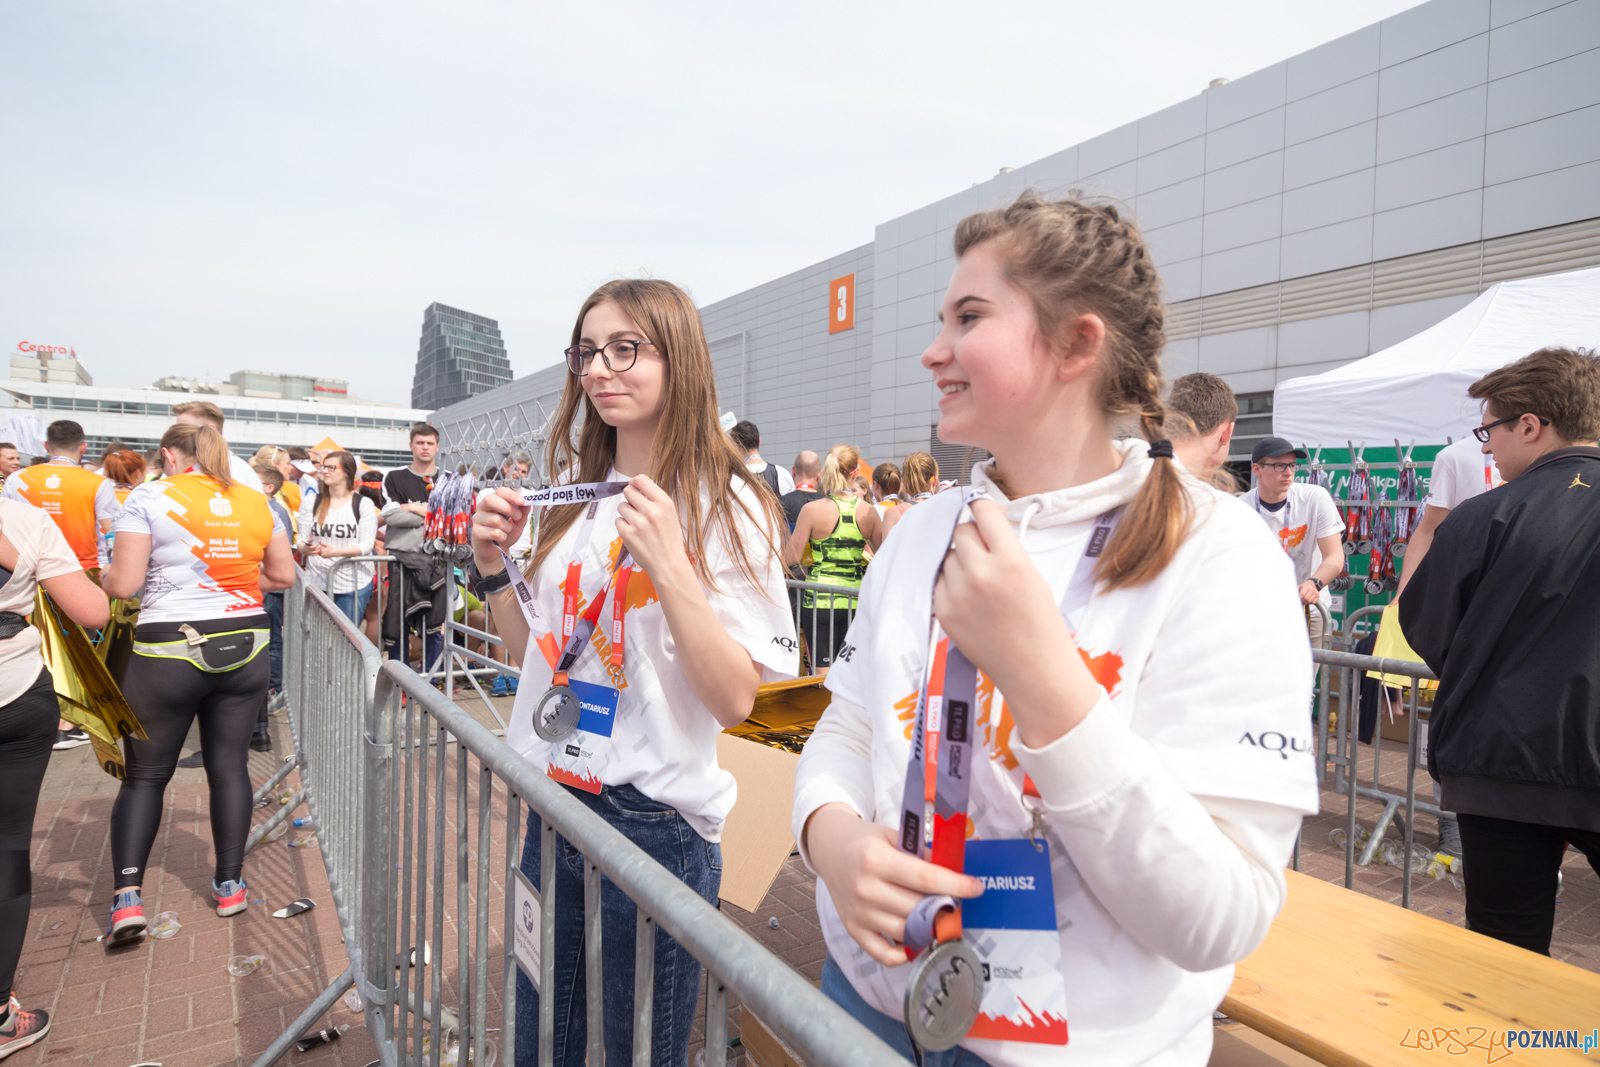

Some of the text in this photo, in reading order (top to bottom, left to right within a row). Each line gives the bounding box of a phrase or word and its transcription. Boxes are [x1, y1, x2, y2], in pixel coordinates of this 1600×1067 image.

[837, 285, 847, 322] 3
[523, 487, 596, 502] Mój ślad pozos
[311, 522, 357, 539] AWSM
[209, 538, 222, 546] Mój
[580, 701, 611, 715] ONTARIUSZ
[977, 876, 1036, 891] TARIUSZ
